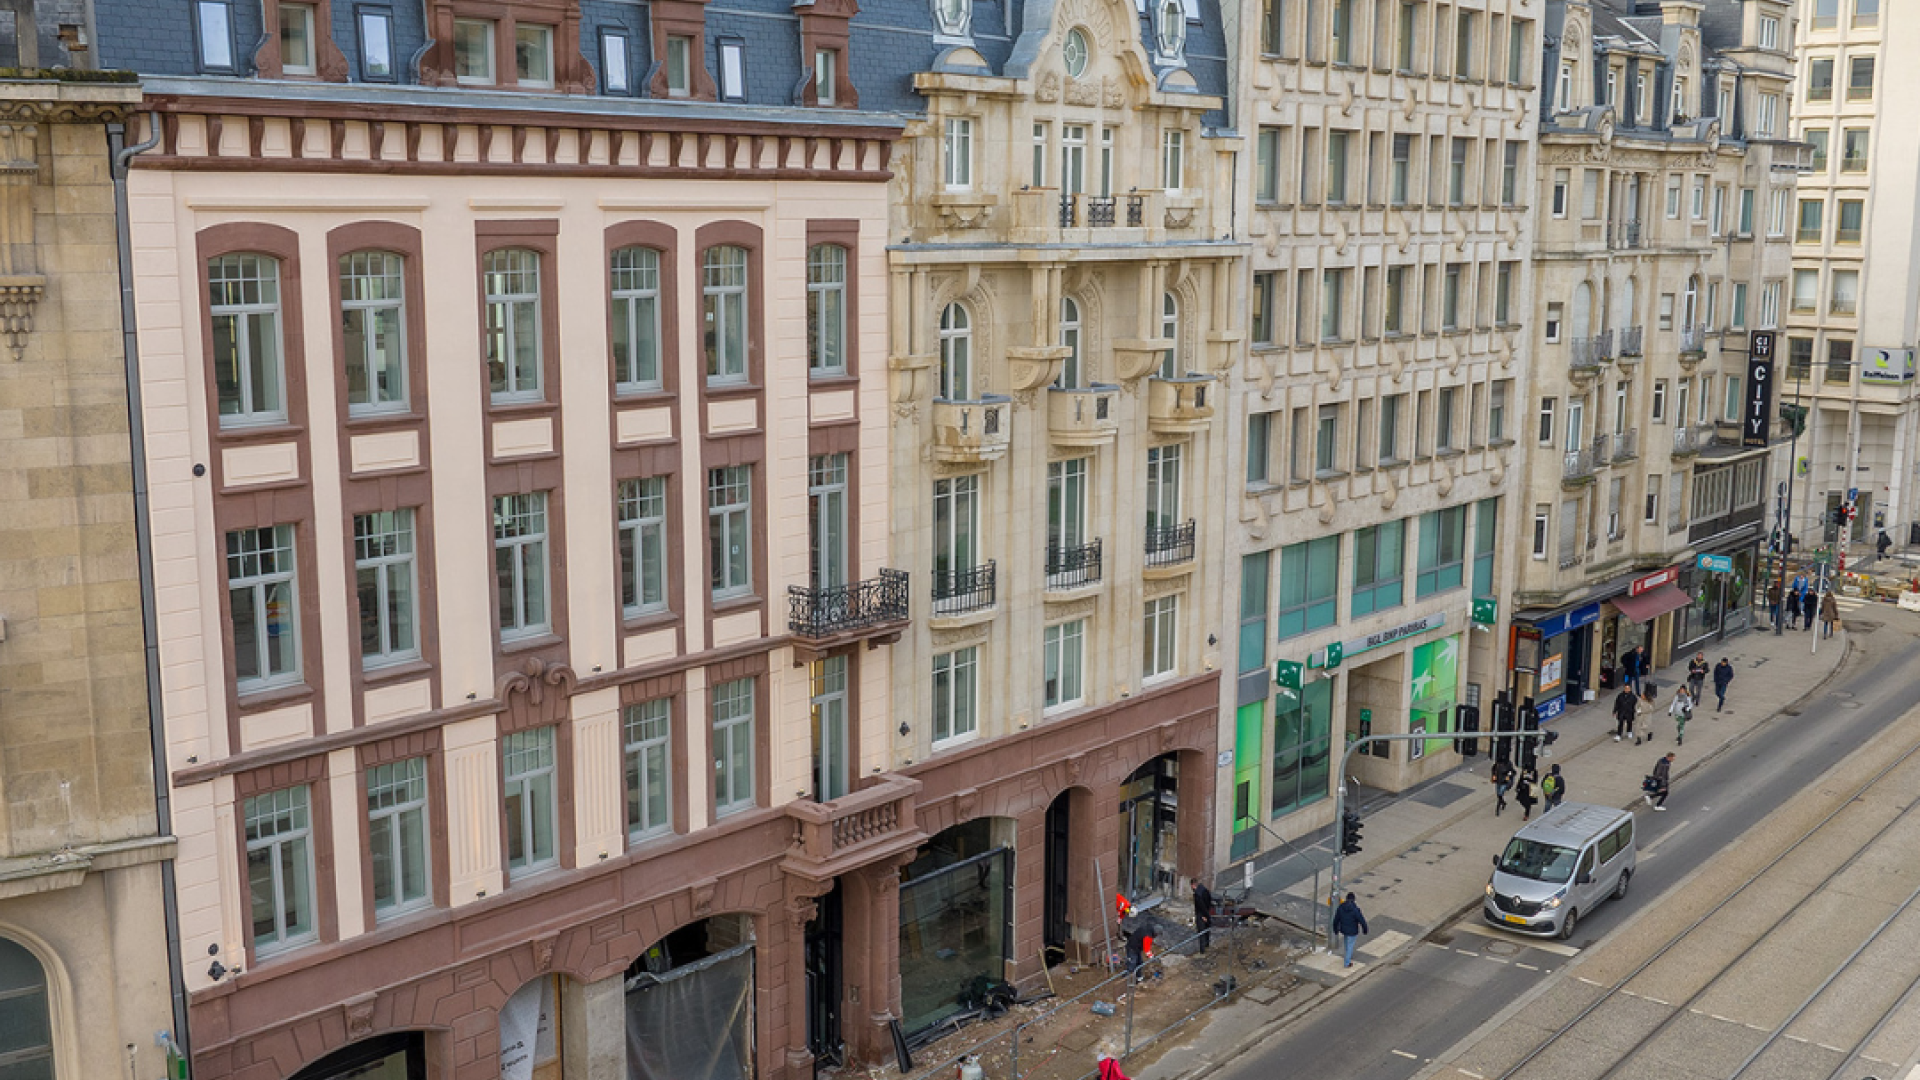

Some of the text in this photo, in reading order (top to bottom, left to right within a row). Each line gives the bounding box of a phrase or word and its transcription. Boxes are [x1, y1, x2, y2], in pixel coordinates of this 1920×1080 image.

[1750, 365, 1766, 434] CITY
[1366, 619, 1427, 647] BGL BNP PARIBAS
